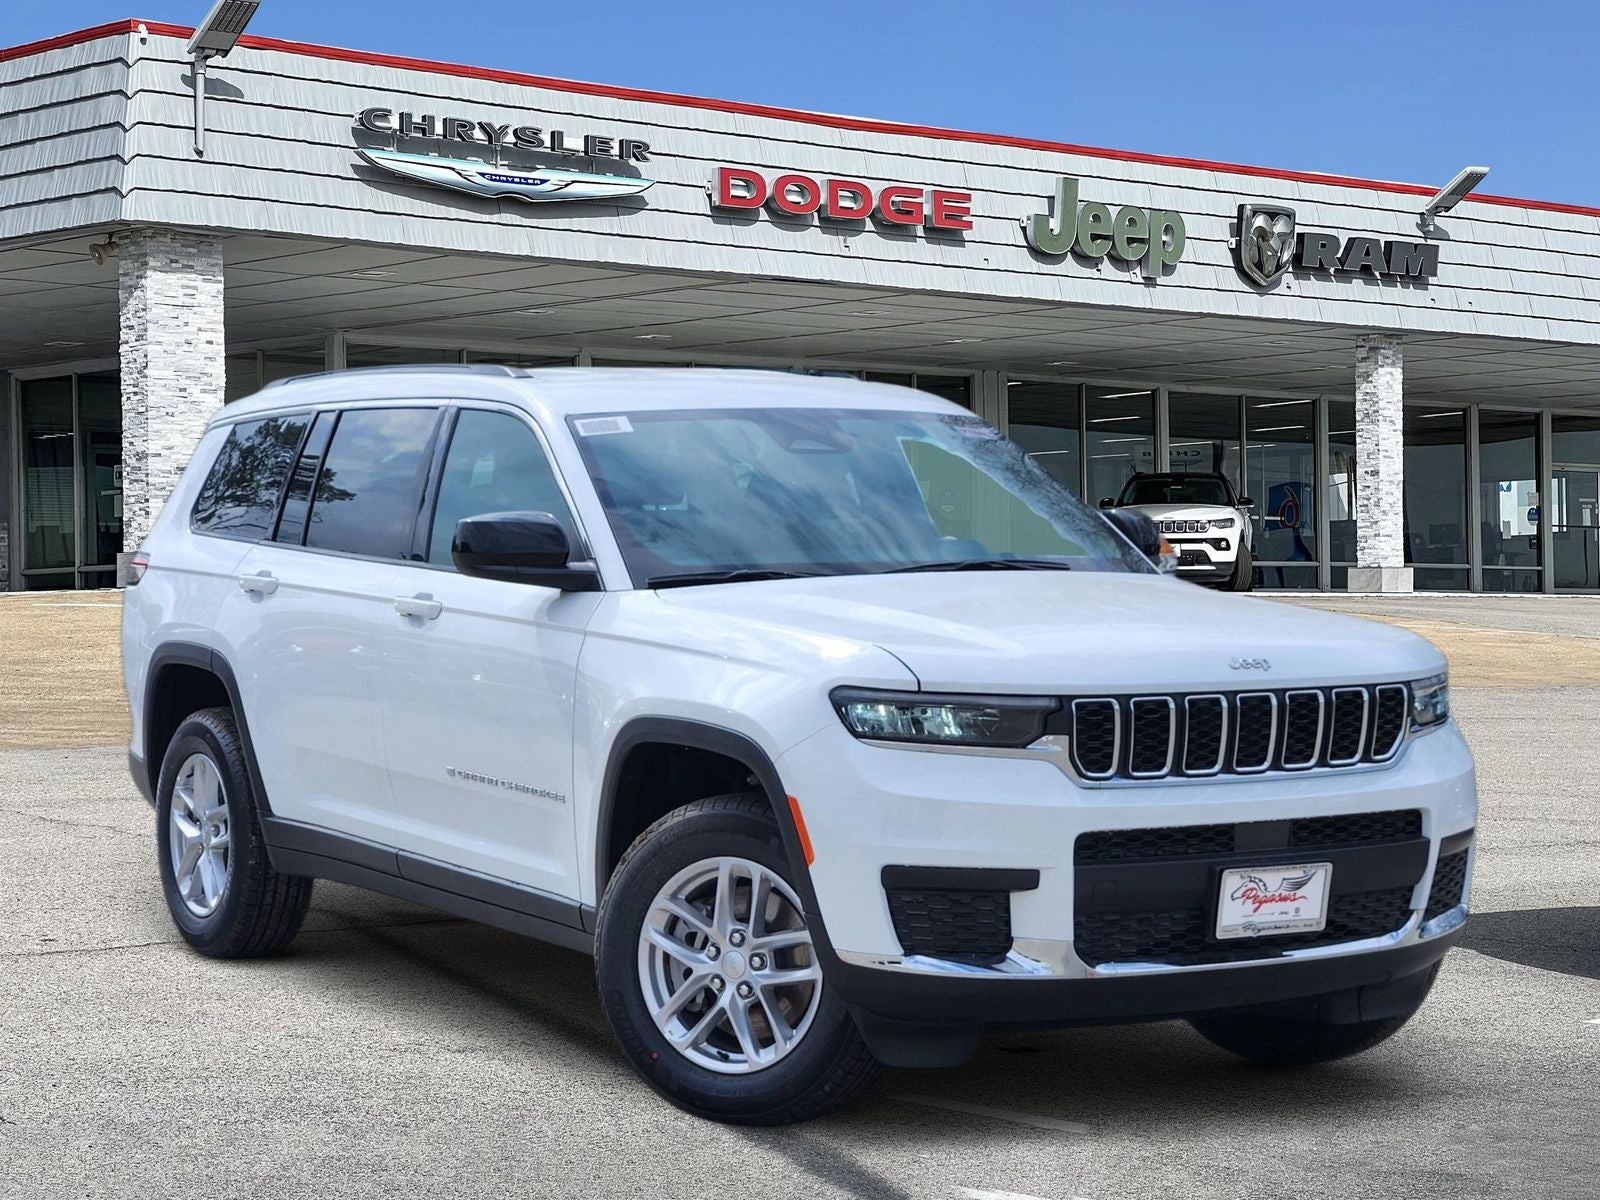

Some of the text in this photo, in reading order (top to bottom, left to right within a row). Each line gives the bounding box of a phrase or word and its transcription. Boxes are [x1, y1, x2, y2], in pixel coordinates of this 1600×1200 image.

[357, 106, 650, 162] CHRYSLER
[484, 174, 541, 185] CHRYSLER
[711, 167, 973, 231] DODGE
[1026, 177, 1186, 279] Jeep
[1297, 232, 1440, 278] RAM
[1228, 656, 1272, 672] Jeep
[1240, 886, 1308, 914] Pegasus
